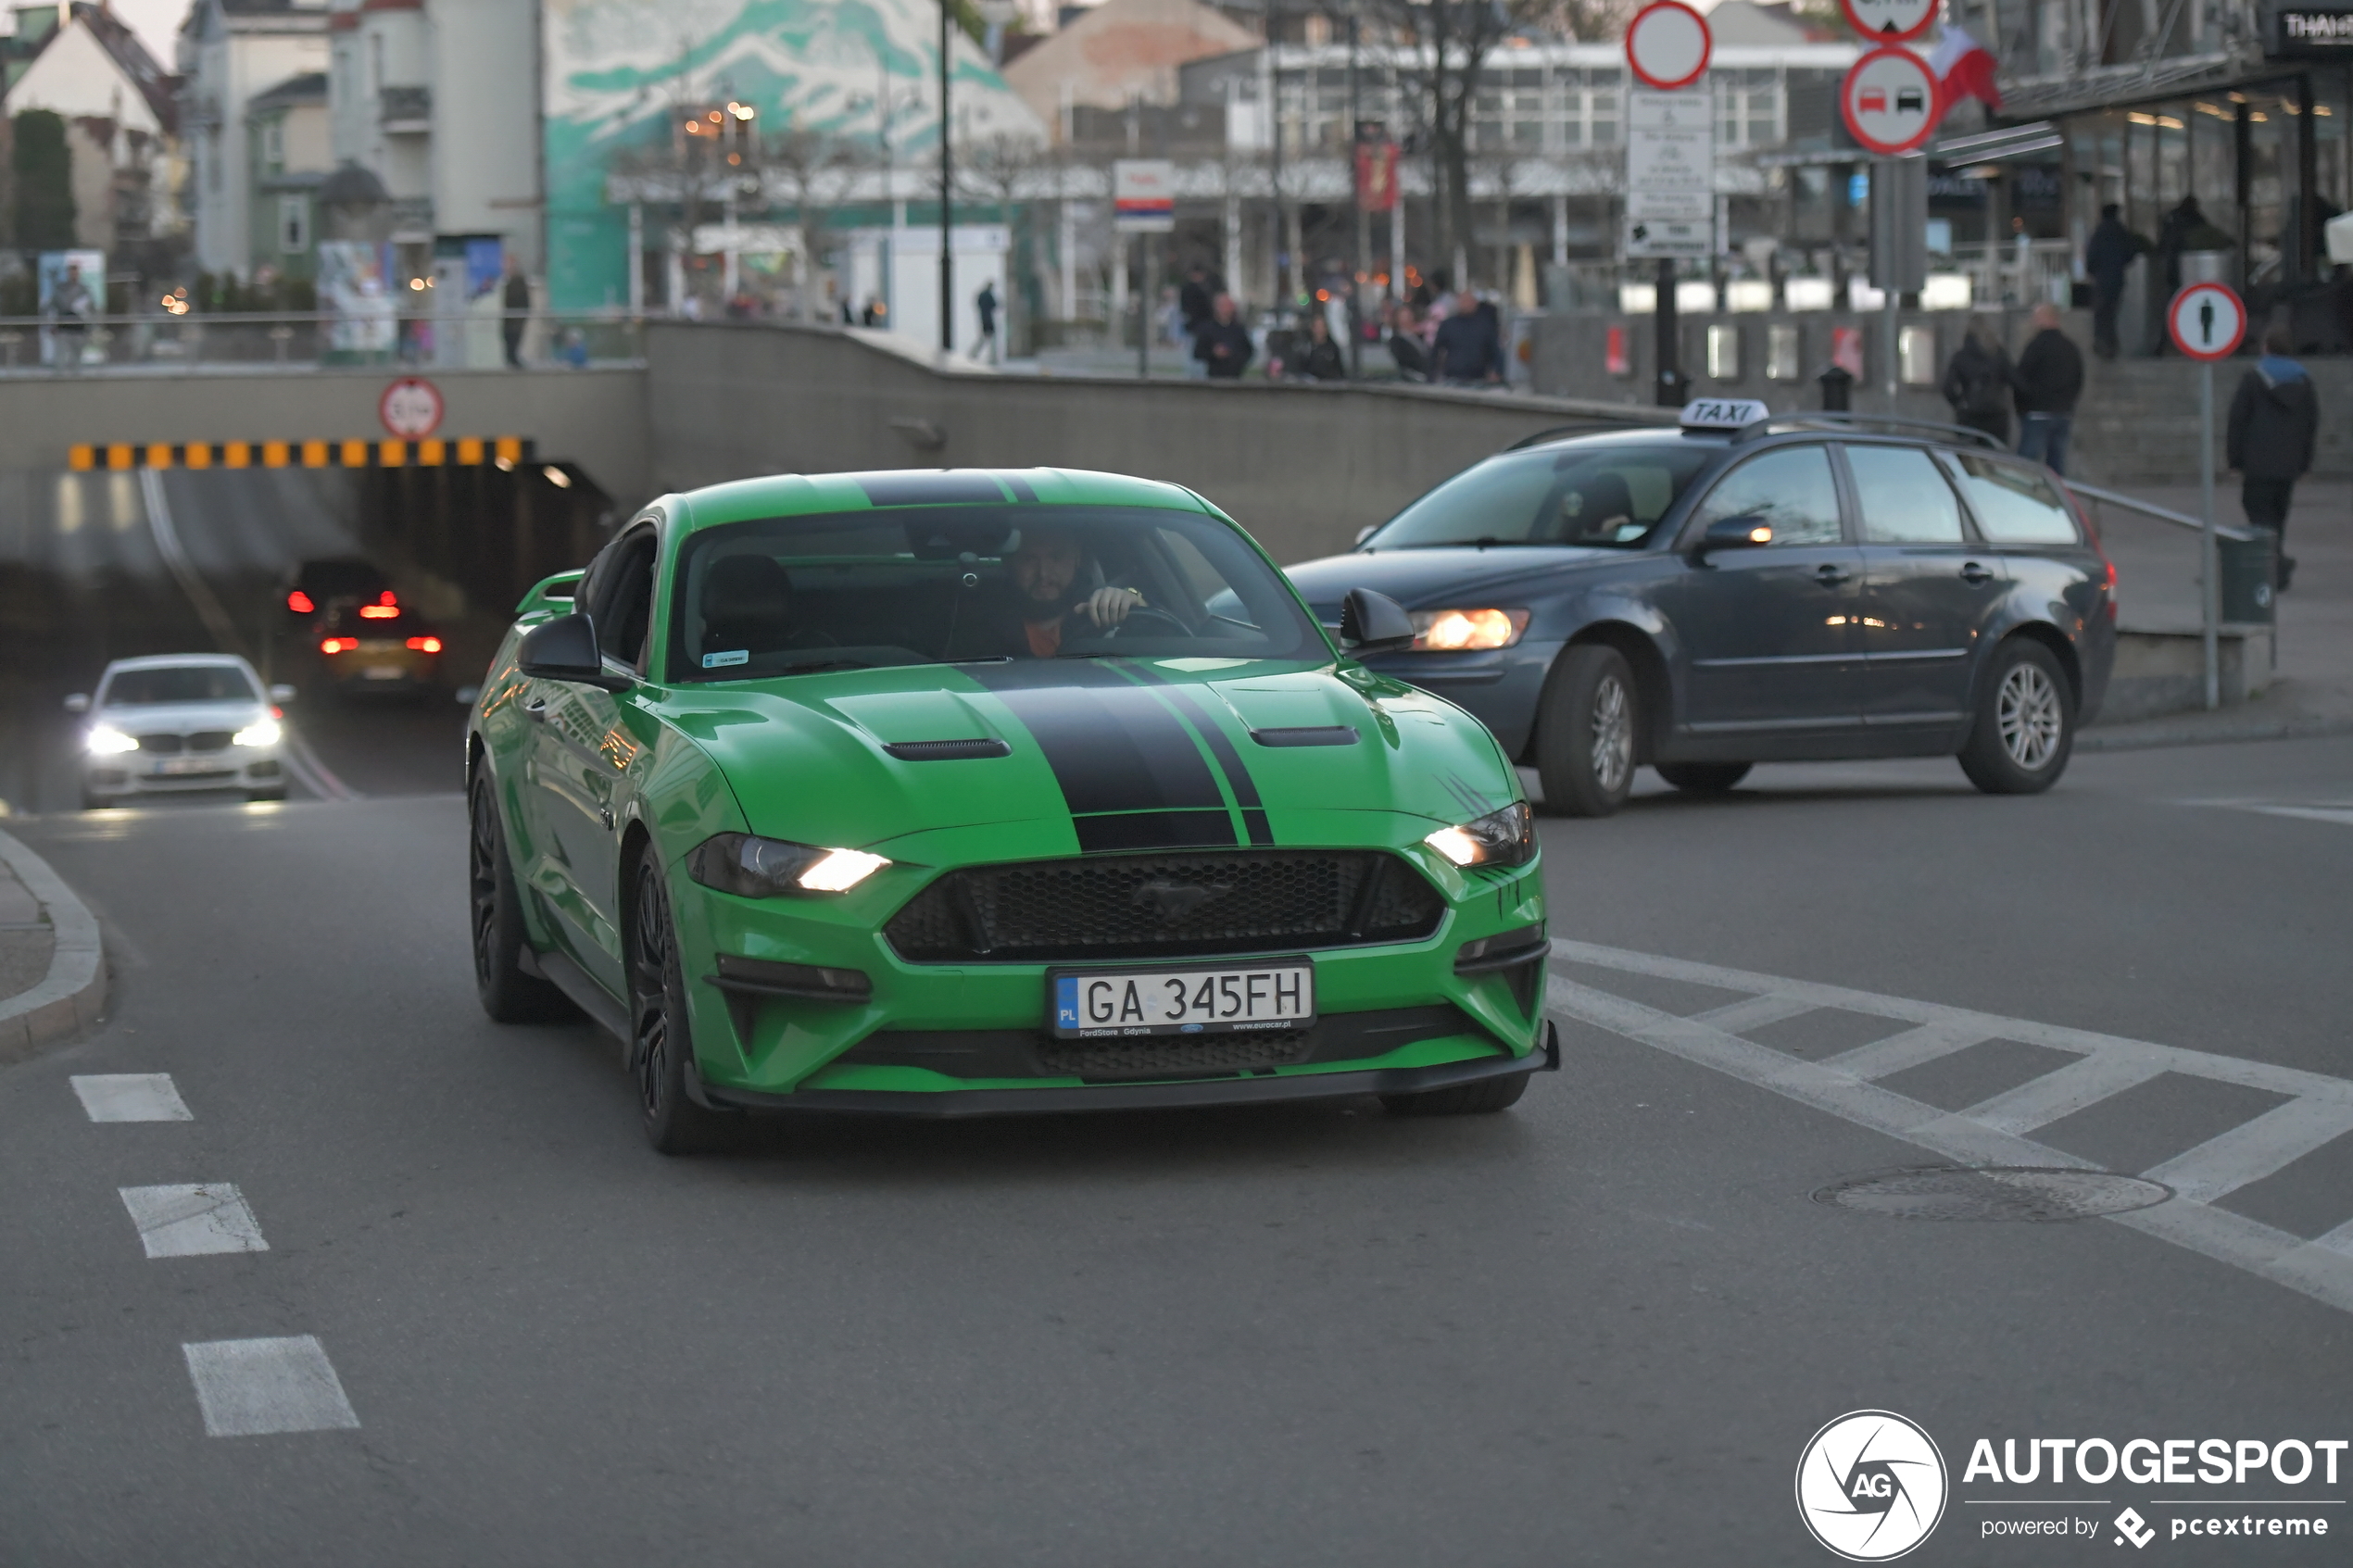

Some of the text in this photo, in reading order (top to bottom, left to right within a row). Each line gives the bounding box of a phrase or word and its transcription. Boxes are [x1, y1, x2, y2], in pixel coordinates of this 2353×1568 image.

[1693, 403, 1752, 421] TAXI
[1088, 972, 1301, 1023] GA 345FH
[1060, 1010, 1076, 1022] PL
[1232, 1020, 1291, 1030] www.eurocar.pl
[1079, 1027, 1151, 1037] FordStore Gdynia
